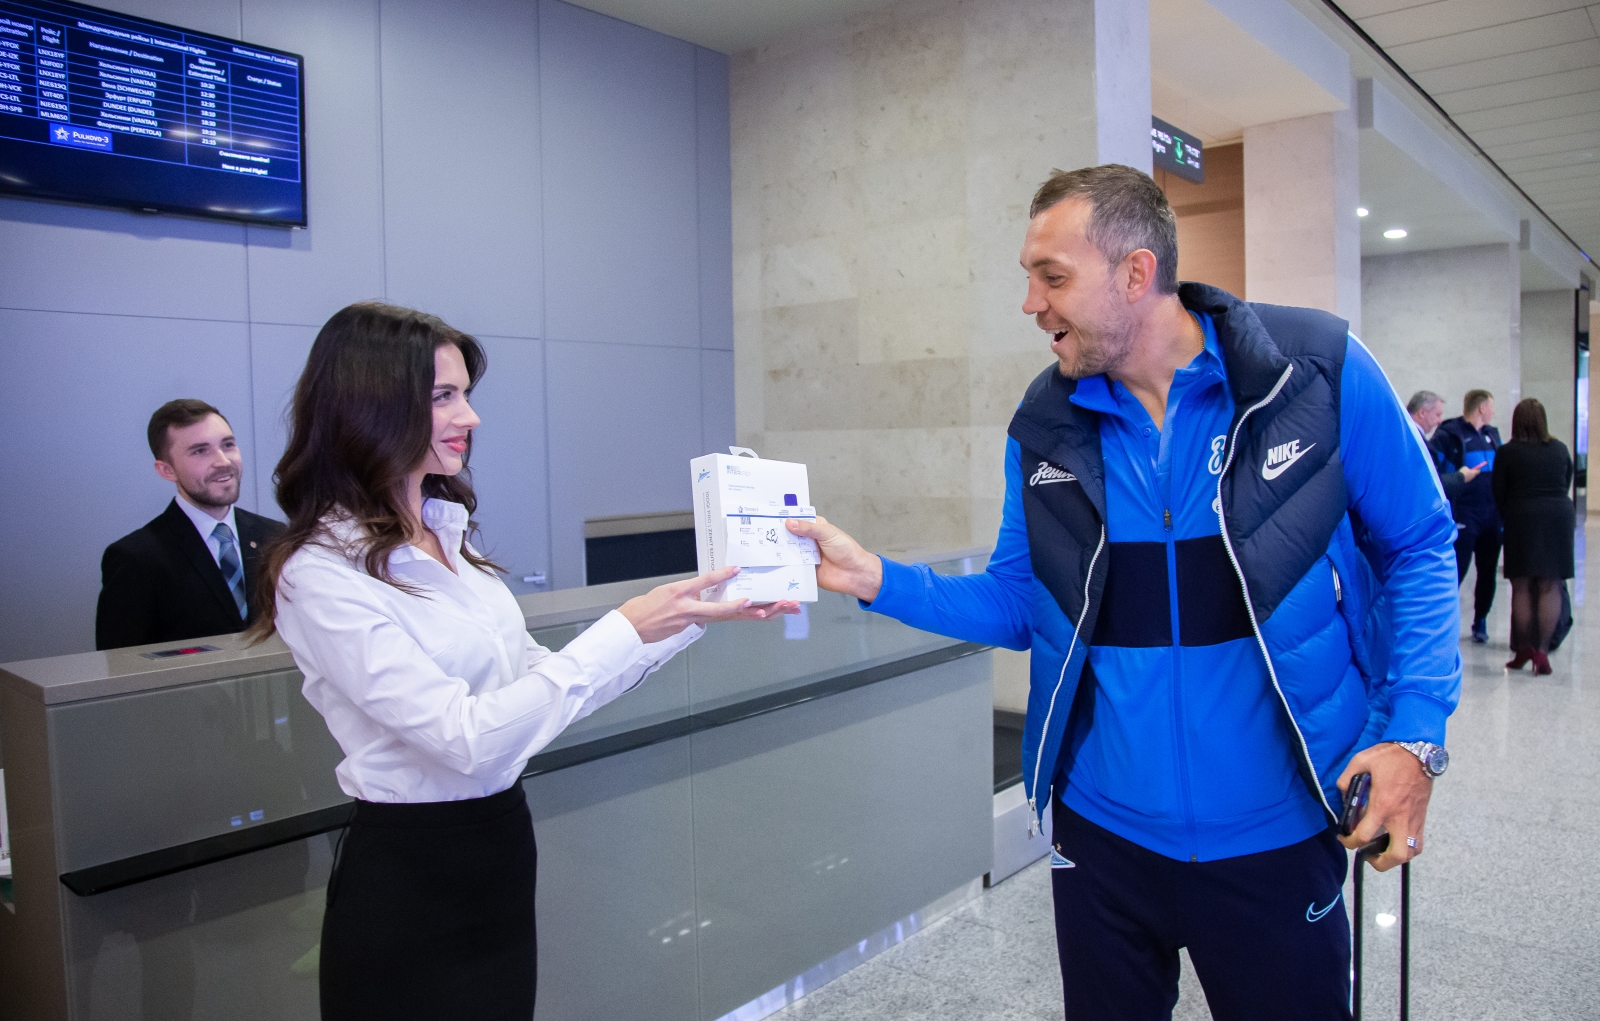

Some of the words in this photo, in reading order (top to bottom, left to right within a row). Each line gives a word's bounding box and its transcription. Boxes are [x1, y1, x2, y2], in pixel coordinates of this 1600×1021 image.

[42, 34, 60, 45] Flight
[154, 39, 189, 51] International
[133, 50, 164, 63] Destination
[102, 101, 128, 112] DUNDEE
[1266, 439, 1300, 466] NIKE
